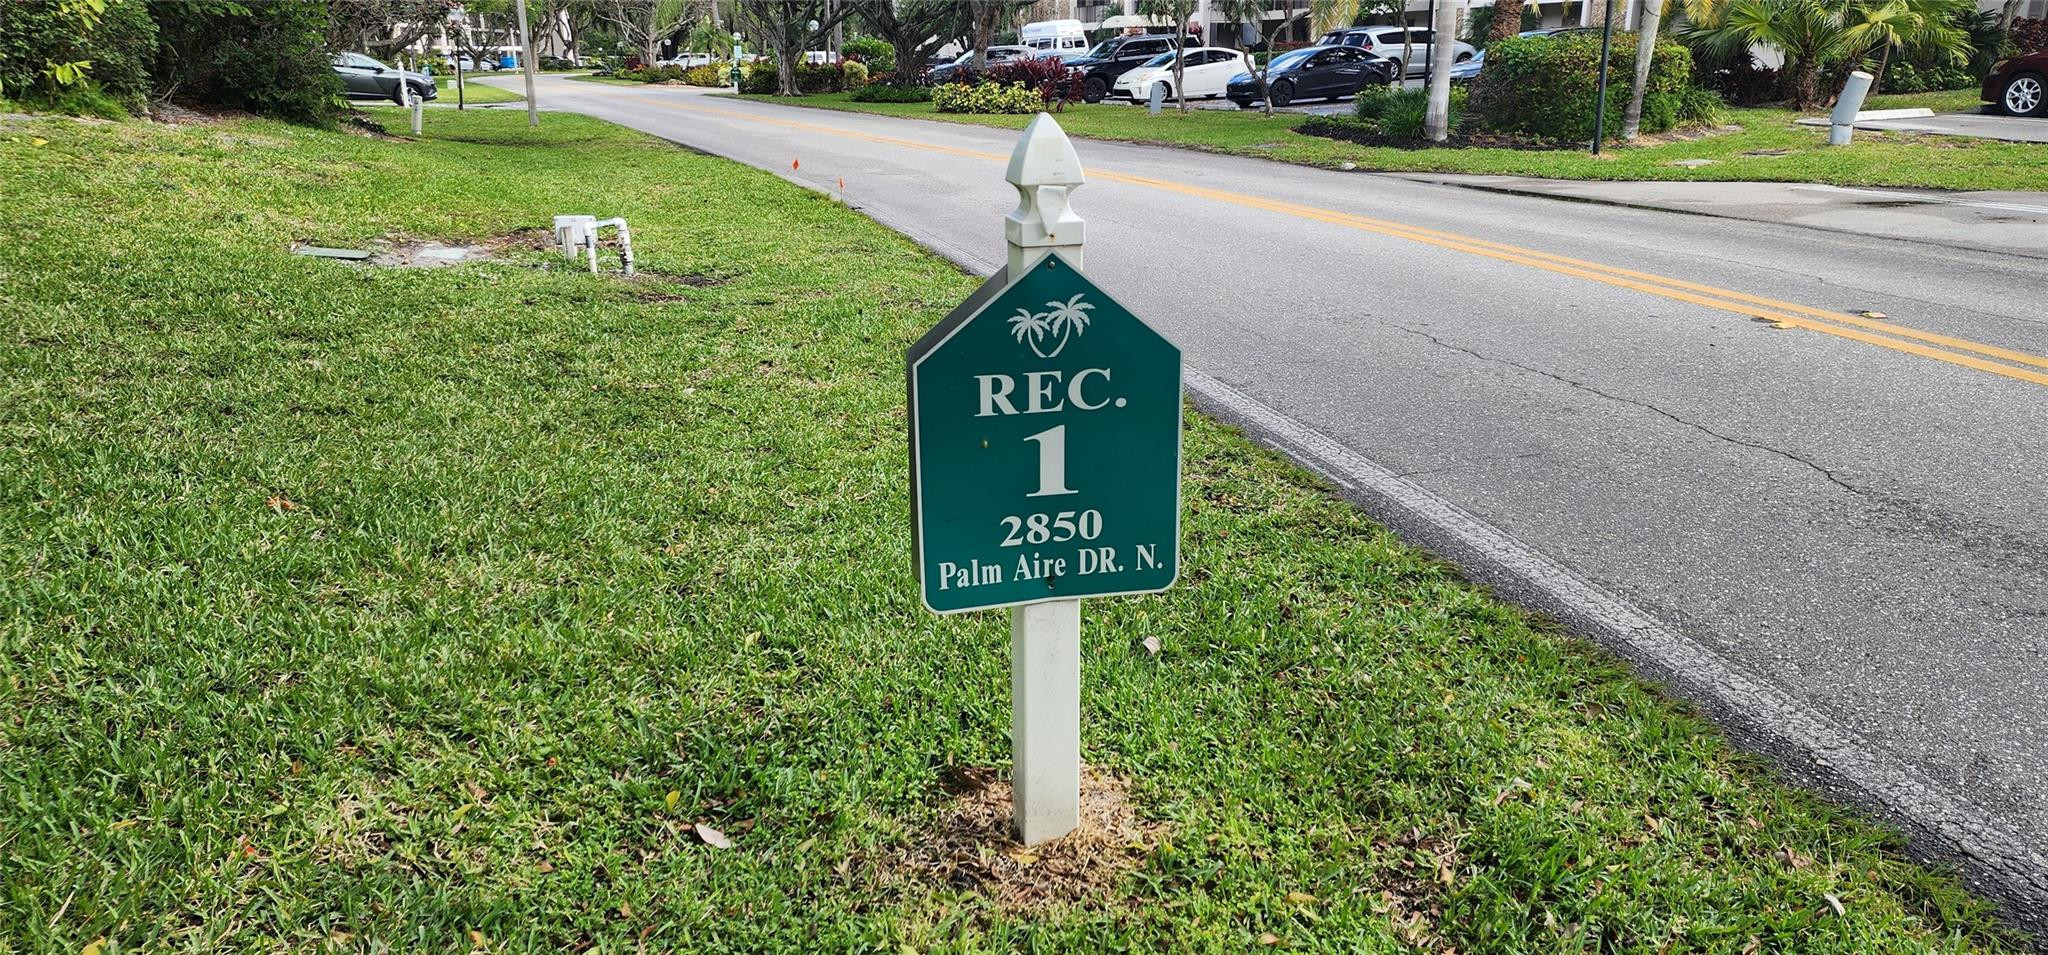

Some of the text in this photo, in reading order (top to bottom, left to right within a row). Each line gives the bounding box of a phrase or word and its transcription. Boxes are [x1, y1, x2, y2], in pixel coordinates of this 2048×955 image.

[974, 367, 1128, 417] REC.
[1023, 424, 1079, 497] 1
[1000, 509, 1103, 547] 2850
[938, 543, 1163, 591] Palm Aire DR. N.
